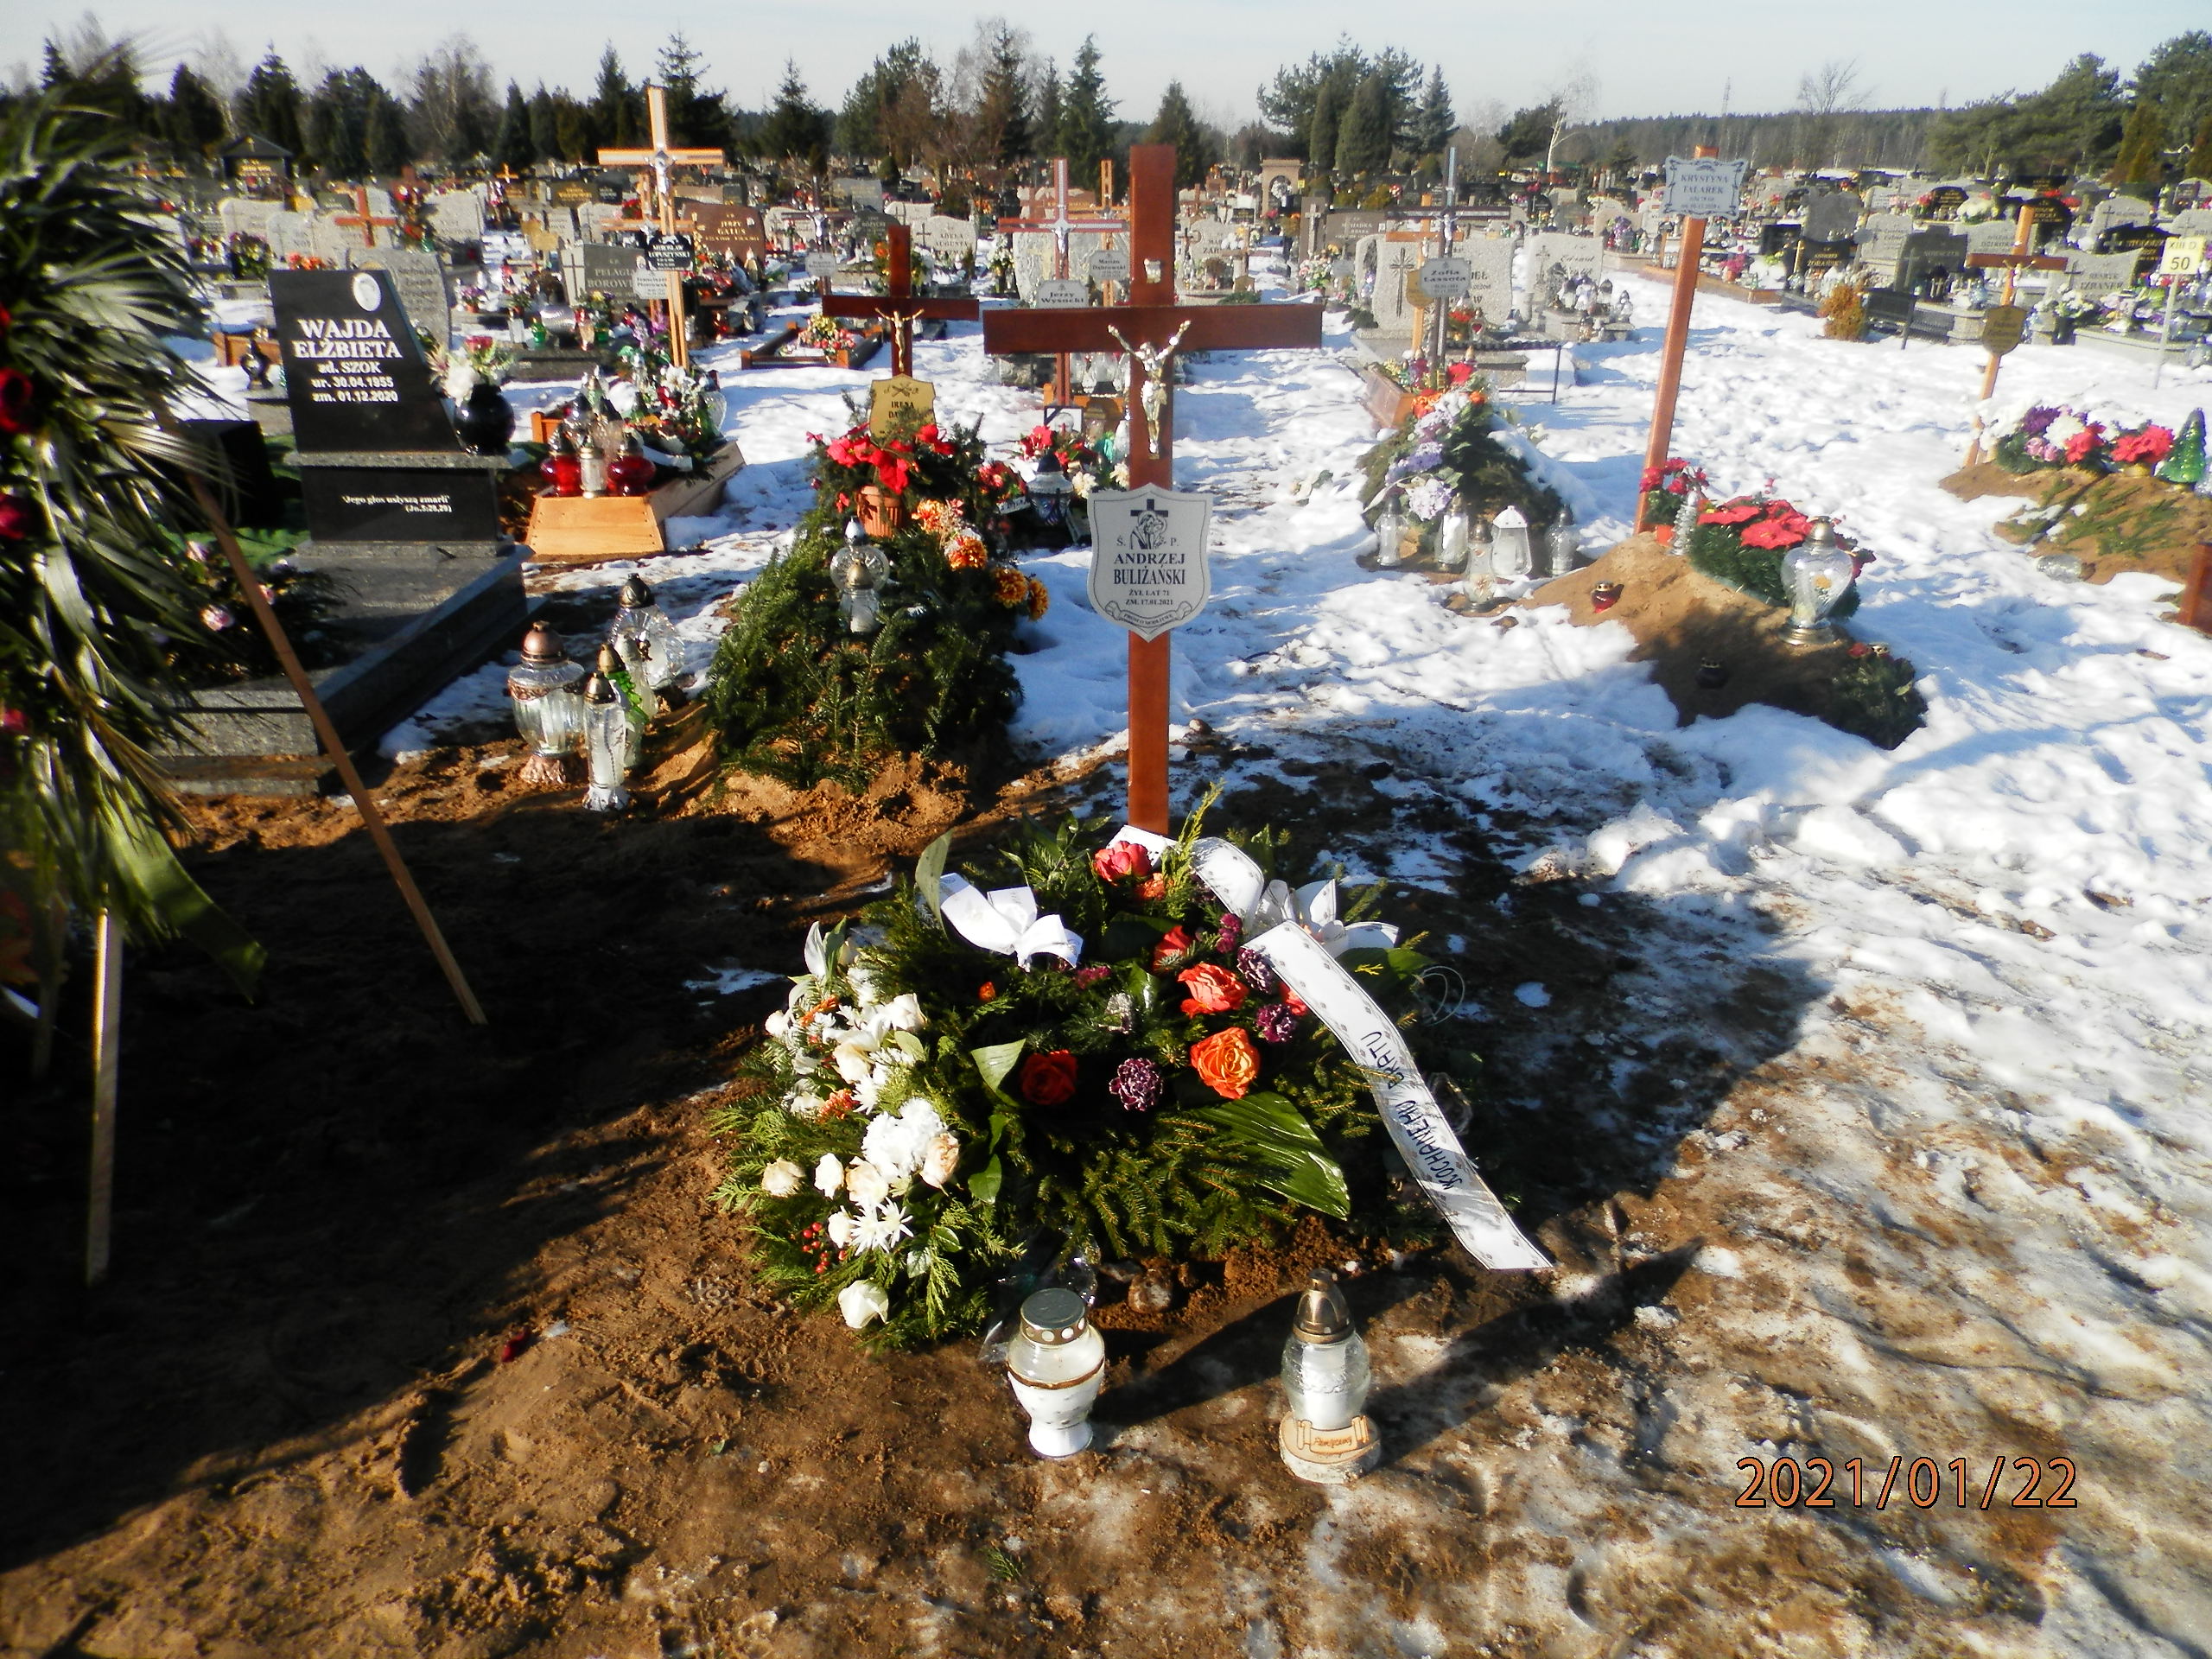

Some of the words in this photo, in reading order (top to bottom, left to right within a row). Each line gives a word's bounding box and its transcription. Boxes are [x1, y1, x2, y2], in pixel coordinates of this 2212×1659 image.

[2171, 257, 2190, 270] 50
[297, 318, 391, 339] WAJDA
[291, 338, 404, 359] ELŻBIETA
[340, 360, 382, 373] SZOK
[310, 378, 331, 388] ur.
[332, 376, 394, 388] 30.04.1955
[311, 392, 336, 402] zm.
[336, 390, 398, 402] 01.12.2020
[1170, 537, 1179, 547] P.
[1114, 553, 1185, 565] ANDRZEJ
[1114, 564, 1185, 585] BULIŻAŃSKI
[1361, 1031, 1405, 1090] BRATU
[1395, 1100, 1462, 1191] KOCHANEMU
